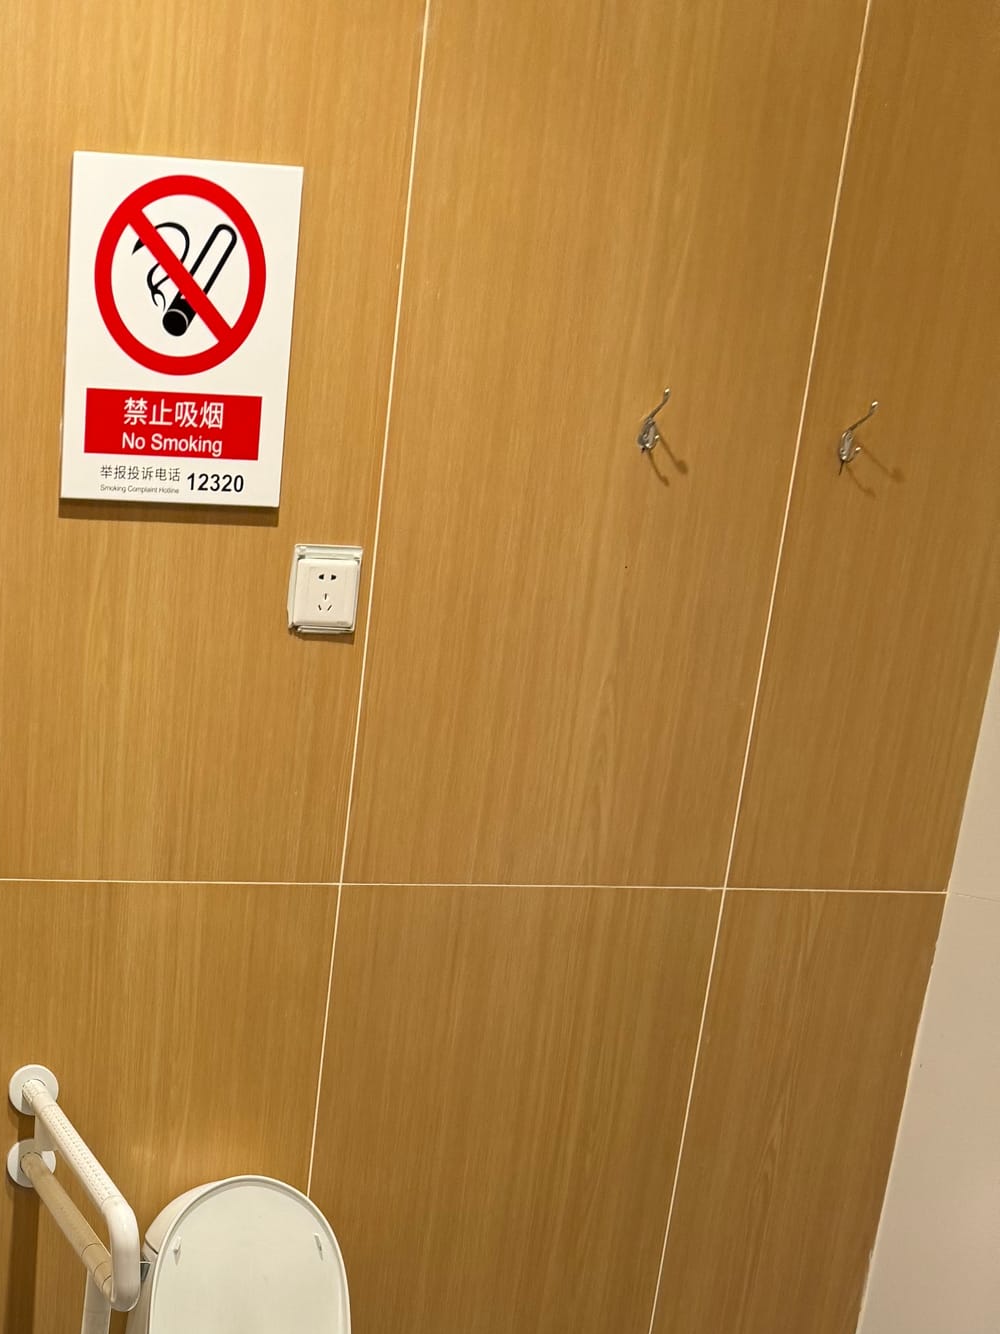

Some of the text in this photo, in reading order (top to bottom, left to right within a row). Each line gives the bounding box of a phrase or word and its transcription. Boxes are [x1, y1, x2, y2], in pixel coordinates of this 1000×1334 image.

[124, 397, 224, 429] 禁止吸烟
[121, 432, 223, 457] No Smoking
[100, 465, 245, 494] 举报投诉电话 12320
[100, 484, 127, 494] Smoking
[127, 485, 158, 494] Complaint
